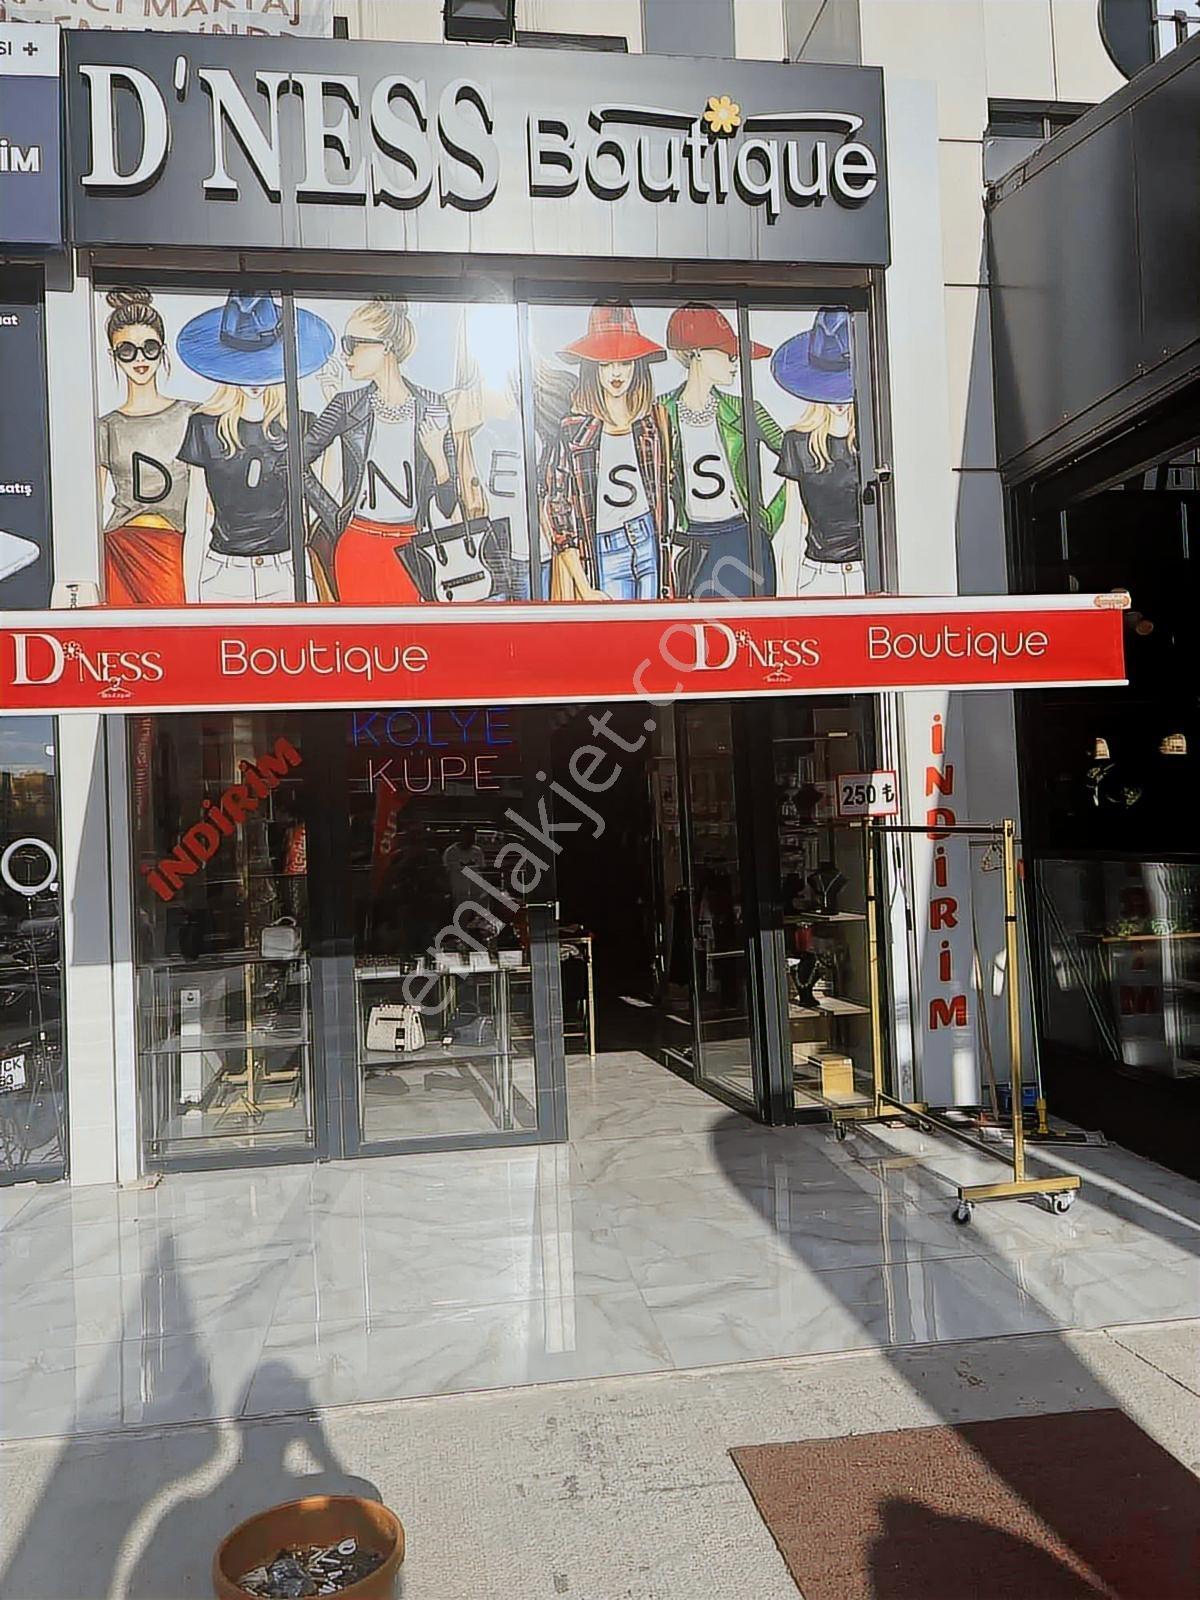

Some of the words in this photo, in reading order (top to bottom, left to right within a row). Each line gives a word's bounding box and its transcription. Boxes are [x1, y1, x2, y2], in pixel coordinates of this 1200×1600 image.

[79, 56, 499, 209] D'NESS
[528, 102, 878, 224] Boutique
[220, 640, 429, 682] Boutique
[868, 625, 1049, 665] Boutique
[352, 708, 513, 748] KOLYE
[369, 750, 502, 794] KÜPE
[842, 784, 877, 806] 250
[140, 736, 303, 902] İNDİRİM
[925, 713, 968, 1031] İNDİRİM
